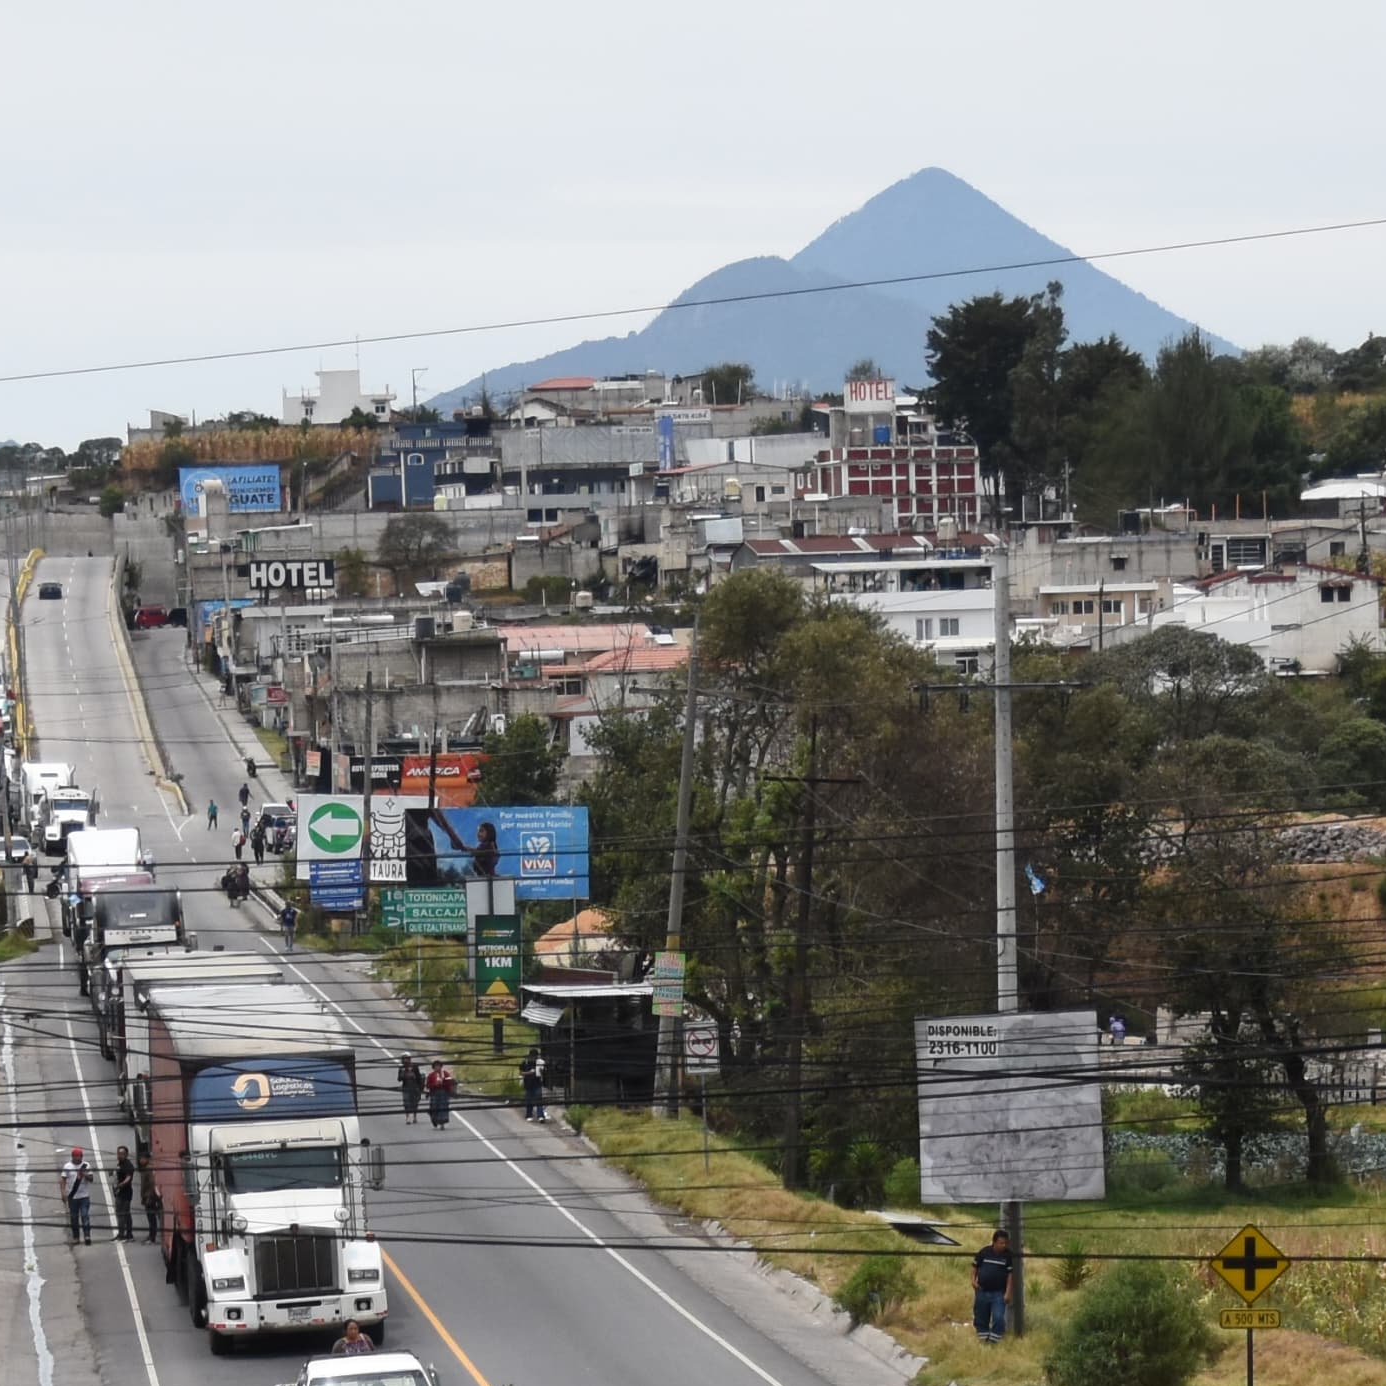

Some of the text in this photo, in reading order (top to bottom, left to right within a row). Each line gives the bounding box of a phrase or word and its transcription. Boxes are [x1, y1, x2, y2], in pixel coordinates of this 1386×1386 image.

[849, 381, 892, 401] HOTEL
[229, 493, 275, 505] GUATE
[250, 561, 333, 588] HOTEL
[524, 859, 552, 869] VIVA
[408, 893, 466, 902] TOTONICAPA
[929, 1040, 997, 1055] 2316-1100
